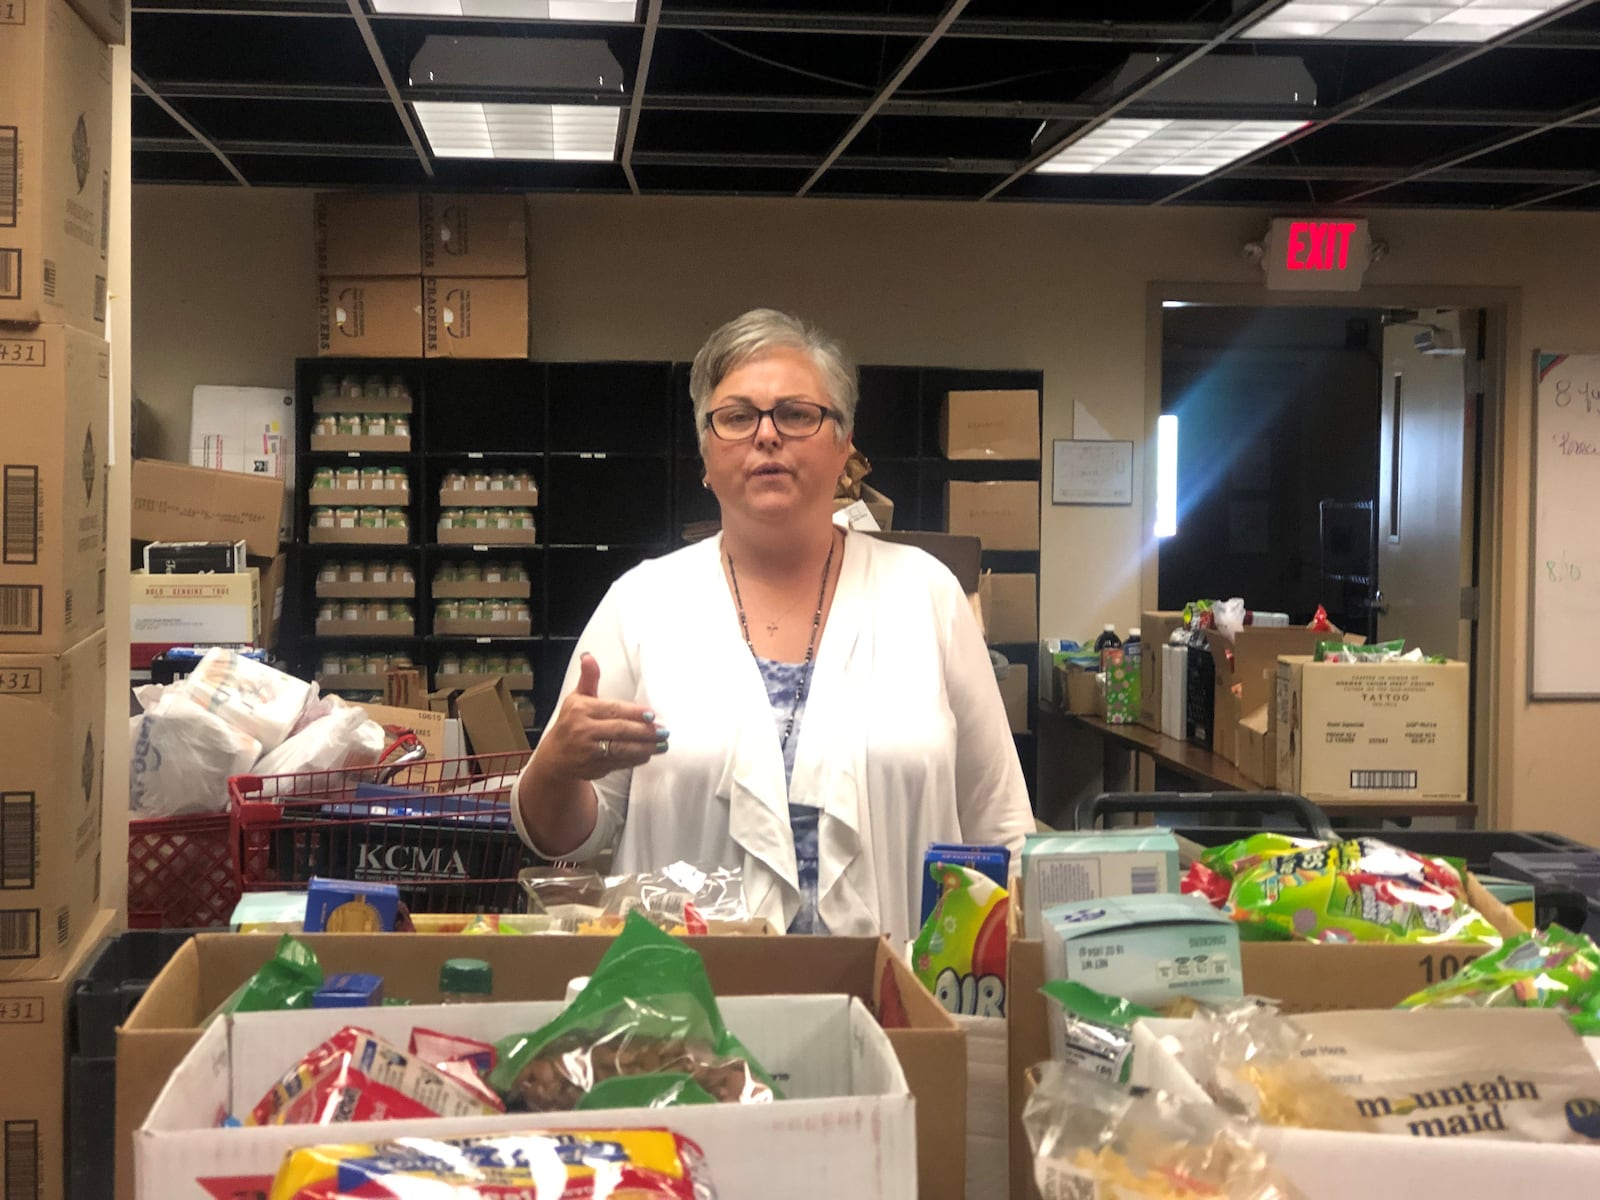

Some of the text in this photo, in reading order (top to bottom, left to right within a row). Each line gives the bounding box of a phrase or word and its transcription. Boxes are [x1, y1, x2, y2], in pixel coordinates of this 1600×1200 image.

[1286, 222, 1357, 271] EXIT
[320, 277, 330, 351] CRACKERS
[425, 278, 437, 351] CRACKERS
[356, 842, 466, 875] KCMA
[1081, 959, 1109, 970] NET WT
[1407, 1104, 1508, 1137] maid
